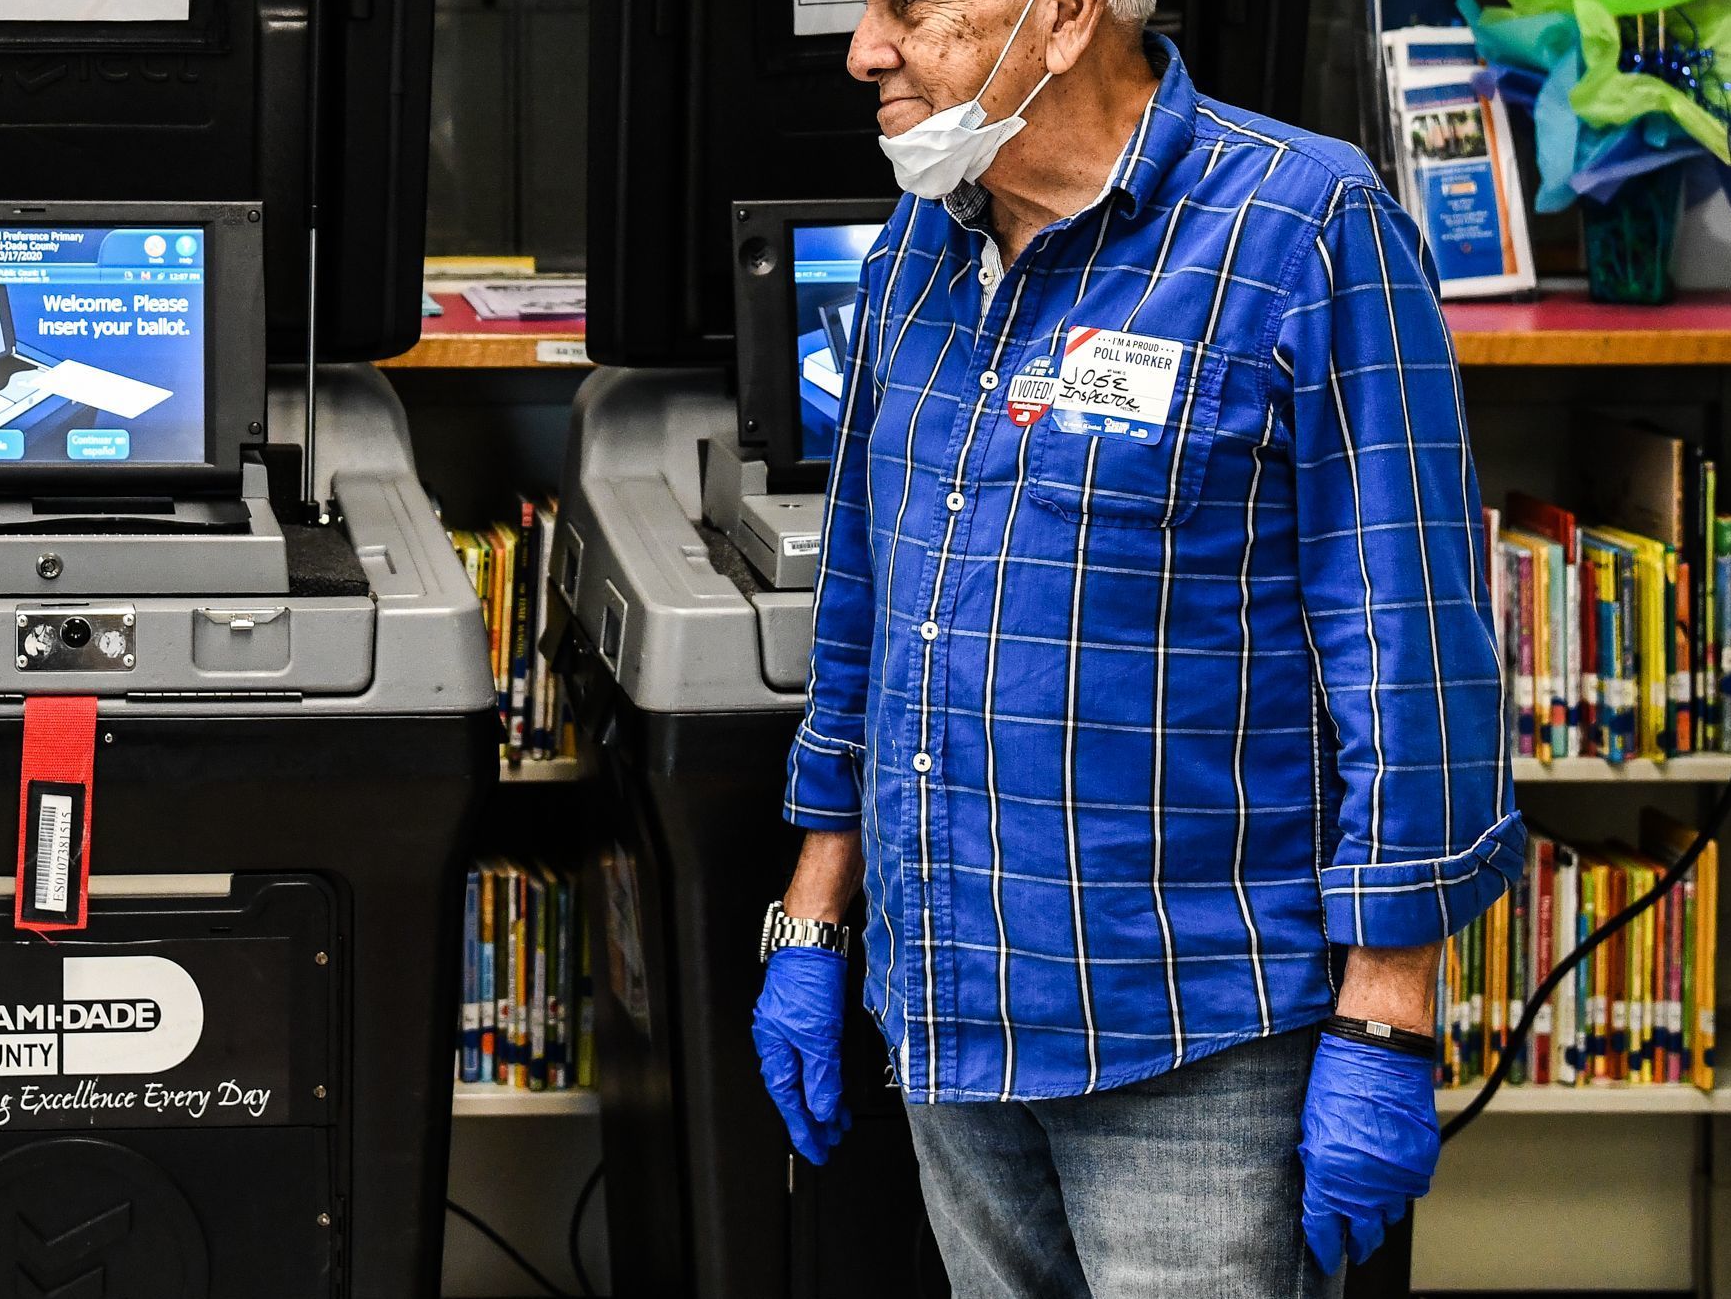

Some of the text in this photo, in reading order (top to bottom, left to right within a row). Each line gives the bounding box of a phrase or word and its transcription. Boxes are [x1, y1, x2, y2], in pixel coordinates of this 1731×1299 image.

[3, 231, 49, 243] Preference
[51, 231, 84, 245] Primary
[29, 241, 60, 254] County
[42, 294, 189, 314] Welcome. Please
[38, 317, 190, 339] insert your ballot.
[1112, 335, 1161, 353] I'M A PROUD
[1093, 346, 1173, 371] POLL WORKER
[1061, 366, 1129, 392] JOSE
[1017, 379, 1055, 401] VOTED!
[71, 434, 113, 446] Continuar
[20, 1077, 139, 1114] Excellence
[144, 1081, 212, 1120] Every
[217, 1078, 272, 1119] Day
